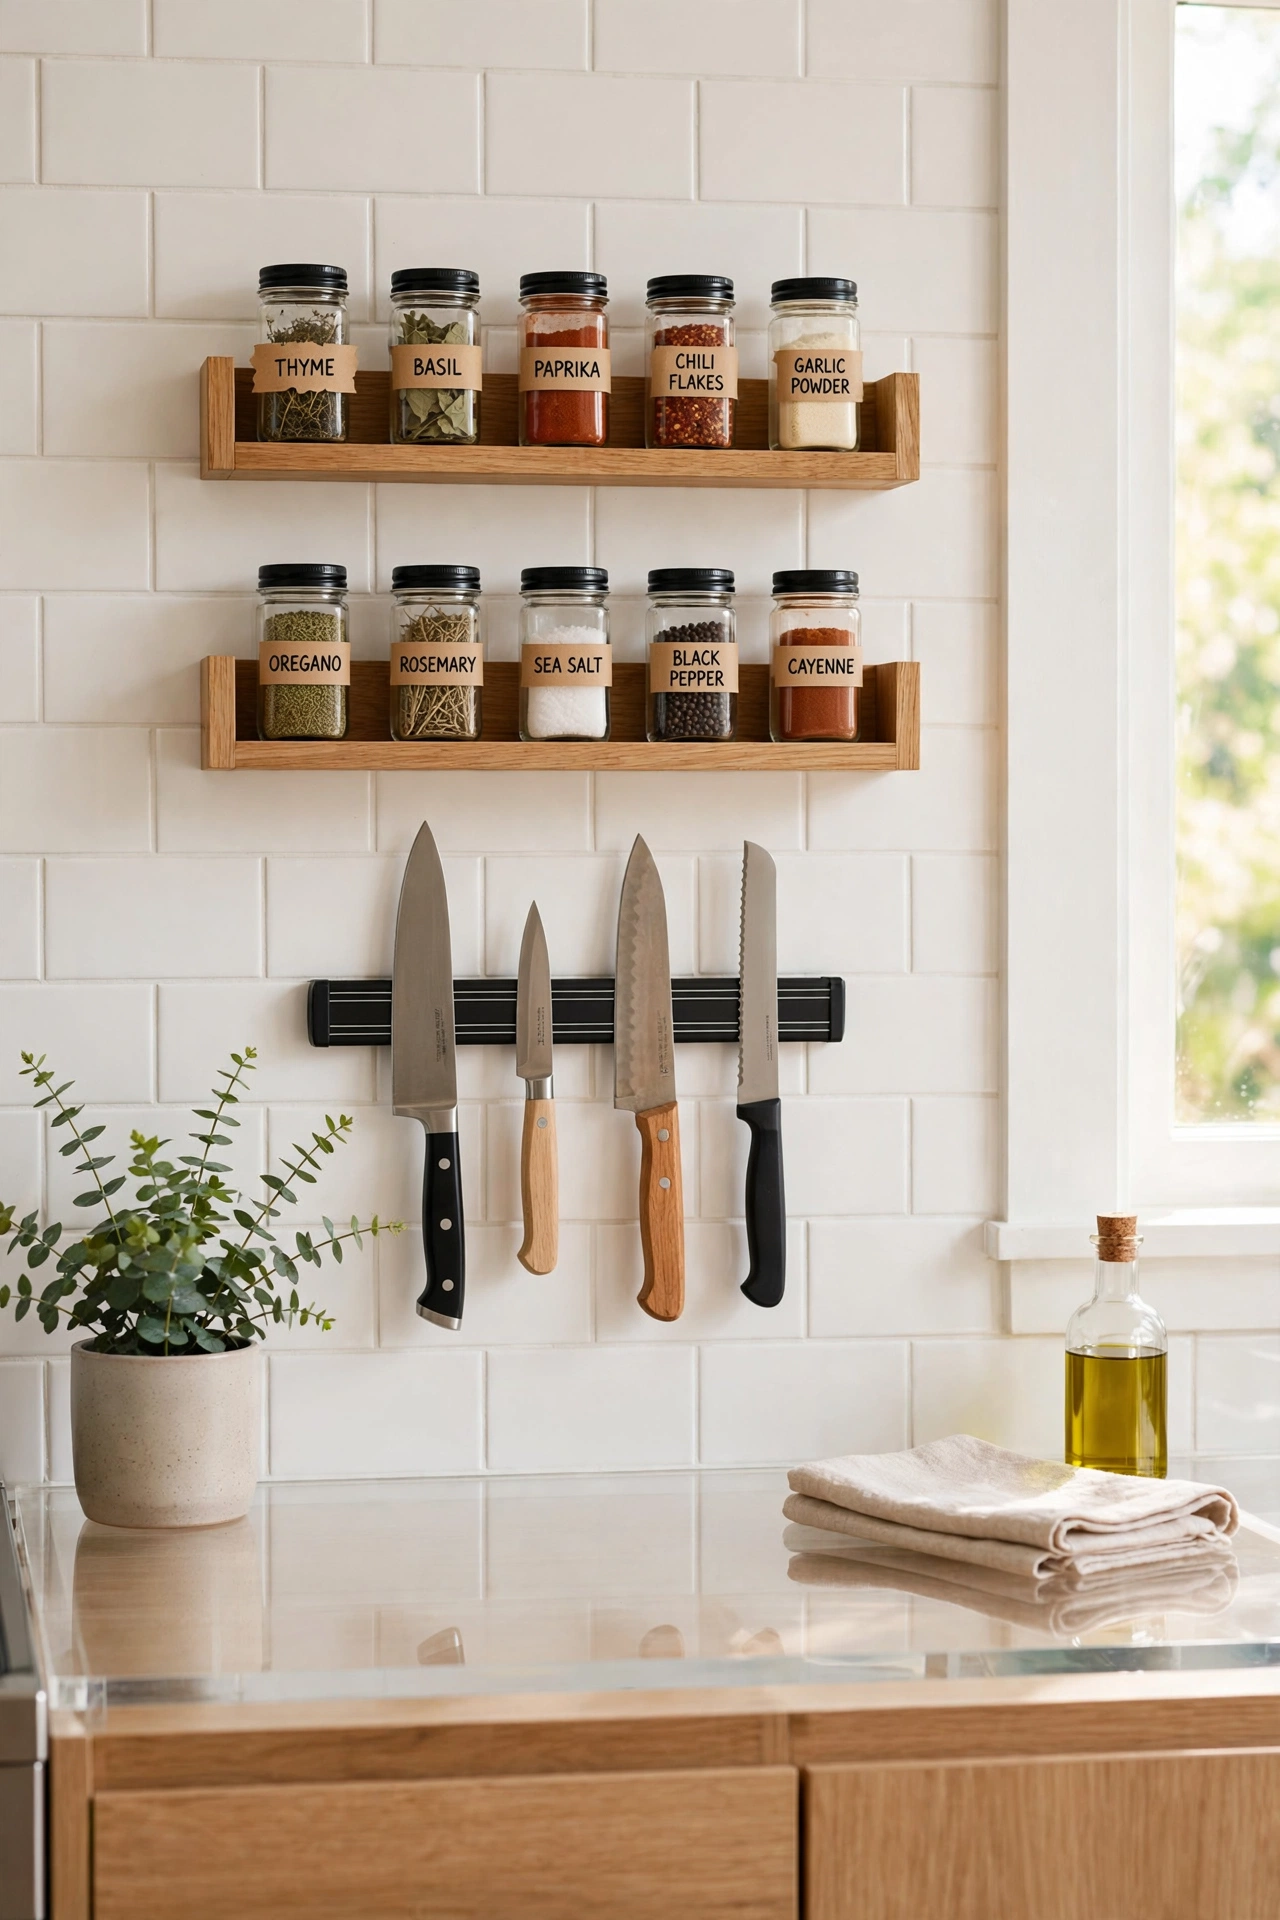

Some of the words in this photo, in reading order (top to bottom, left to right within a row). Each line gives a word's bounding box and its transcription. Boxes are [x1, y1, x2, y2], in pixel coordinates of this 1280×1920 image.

[274, 358, 335, 377] THYME
[414, 358, 462, 376] BASIL
[534, 360, 601, 378] PAPRIKA
[675, 352, 715, 368] CHILI
[794, 357, 846, 374] GARLIC
[669, 373, 724, 391] FLAKES
[791, 377, 850, 395] POWDER
[269, 654, 342, 672] OREGANO
[400, 656, 477, 673] ROSEMARY
[533, 657, 562, 673] SEA
[568, 656, 603, 673] SALT
[673, 650, 721, 667] BLACK
[788, 658, 855, 675] CAYENNE
[670, 669, 725, 687] PEPPER
